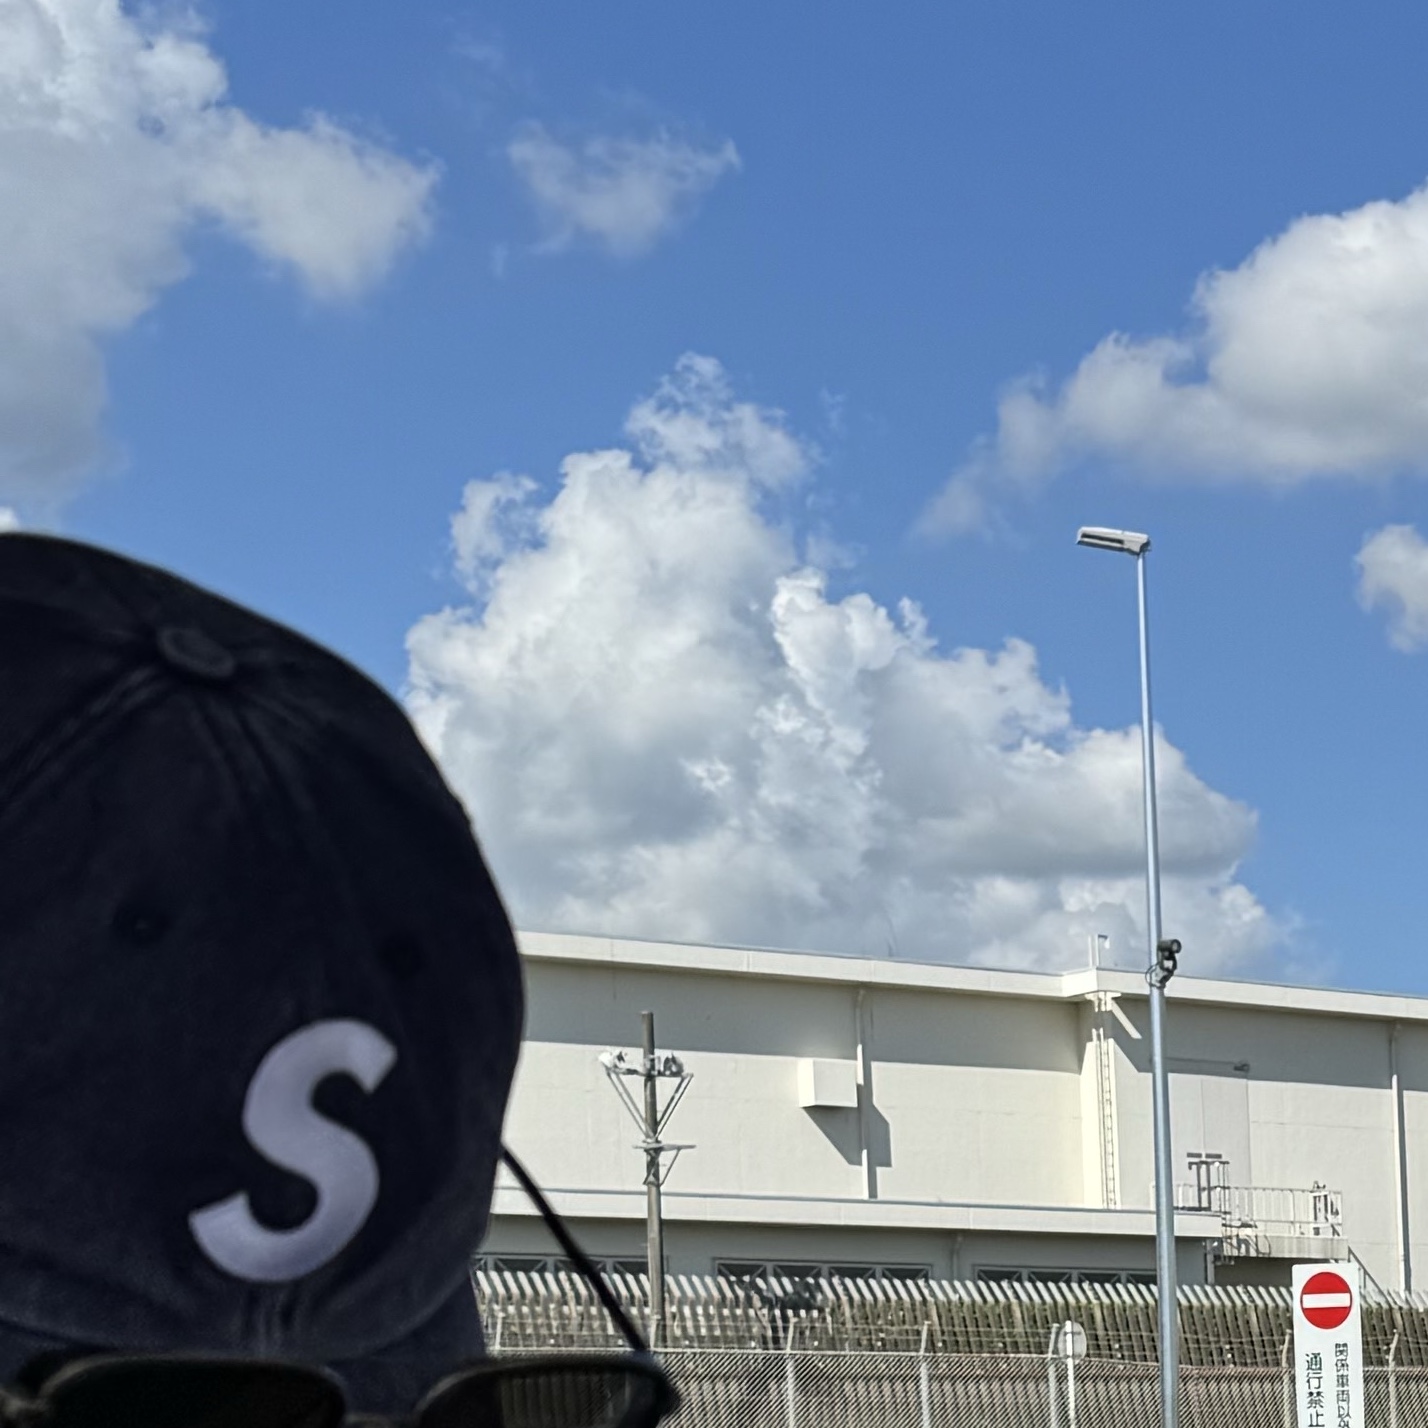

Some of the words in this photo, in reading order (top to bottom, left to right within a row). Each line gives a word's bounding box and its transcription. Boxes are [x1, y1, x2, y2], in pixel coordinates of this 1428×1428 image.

[189, 1018, 397, 1283] S
[1305, 1352, 1325, 1427] 通行禁止
